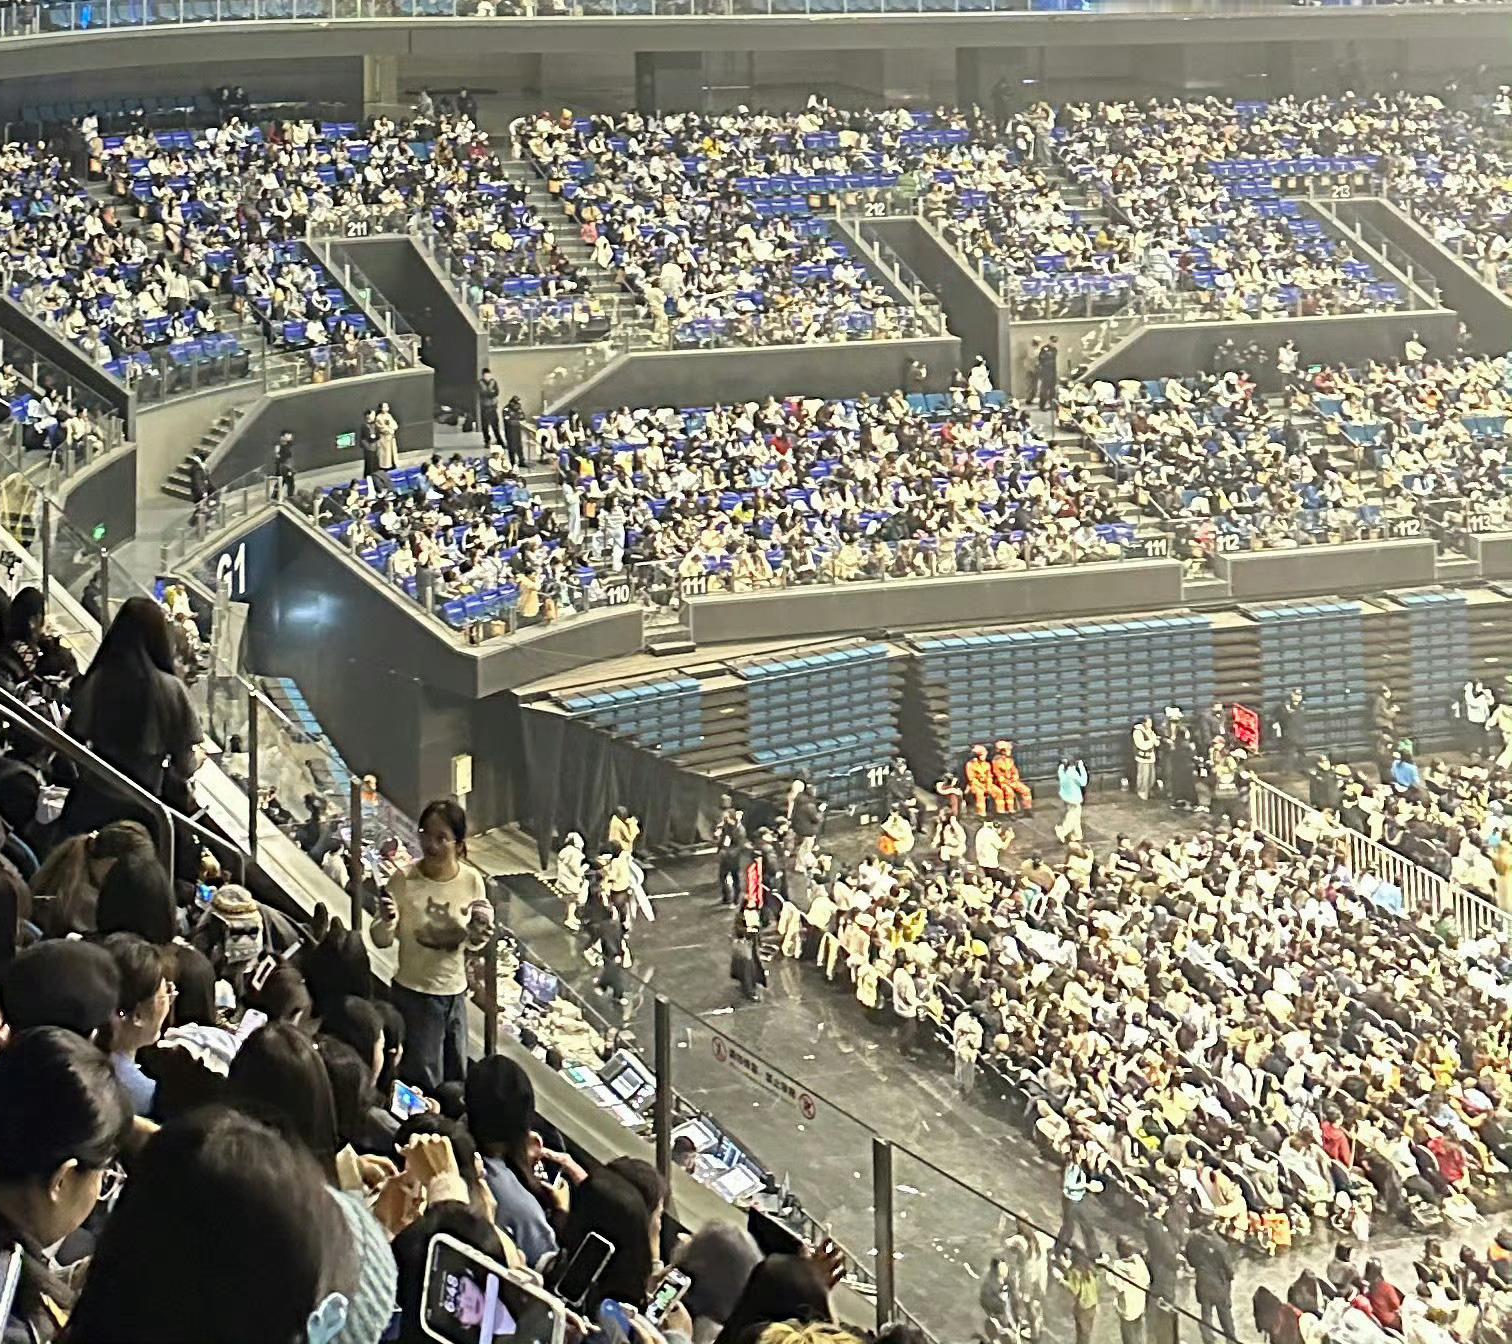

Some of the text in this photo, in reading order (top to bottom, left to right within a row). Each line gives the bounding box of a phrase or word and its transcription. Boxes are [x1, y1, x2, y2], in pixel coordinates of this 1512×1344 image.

[864, 202, 886, 217] 212
[347, 221, 368, 237] 211
[1144, 539, 1167, 557] 111
[1216, 533, 1240, 552] 112
[216, 542, 246, 600] G1
[682, 576, 706, 594] 111
[607, 584, 630, 605] 110
